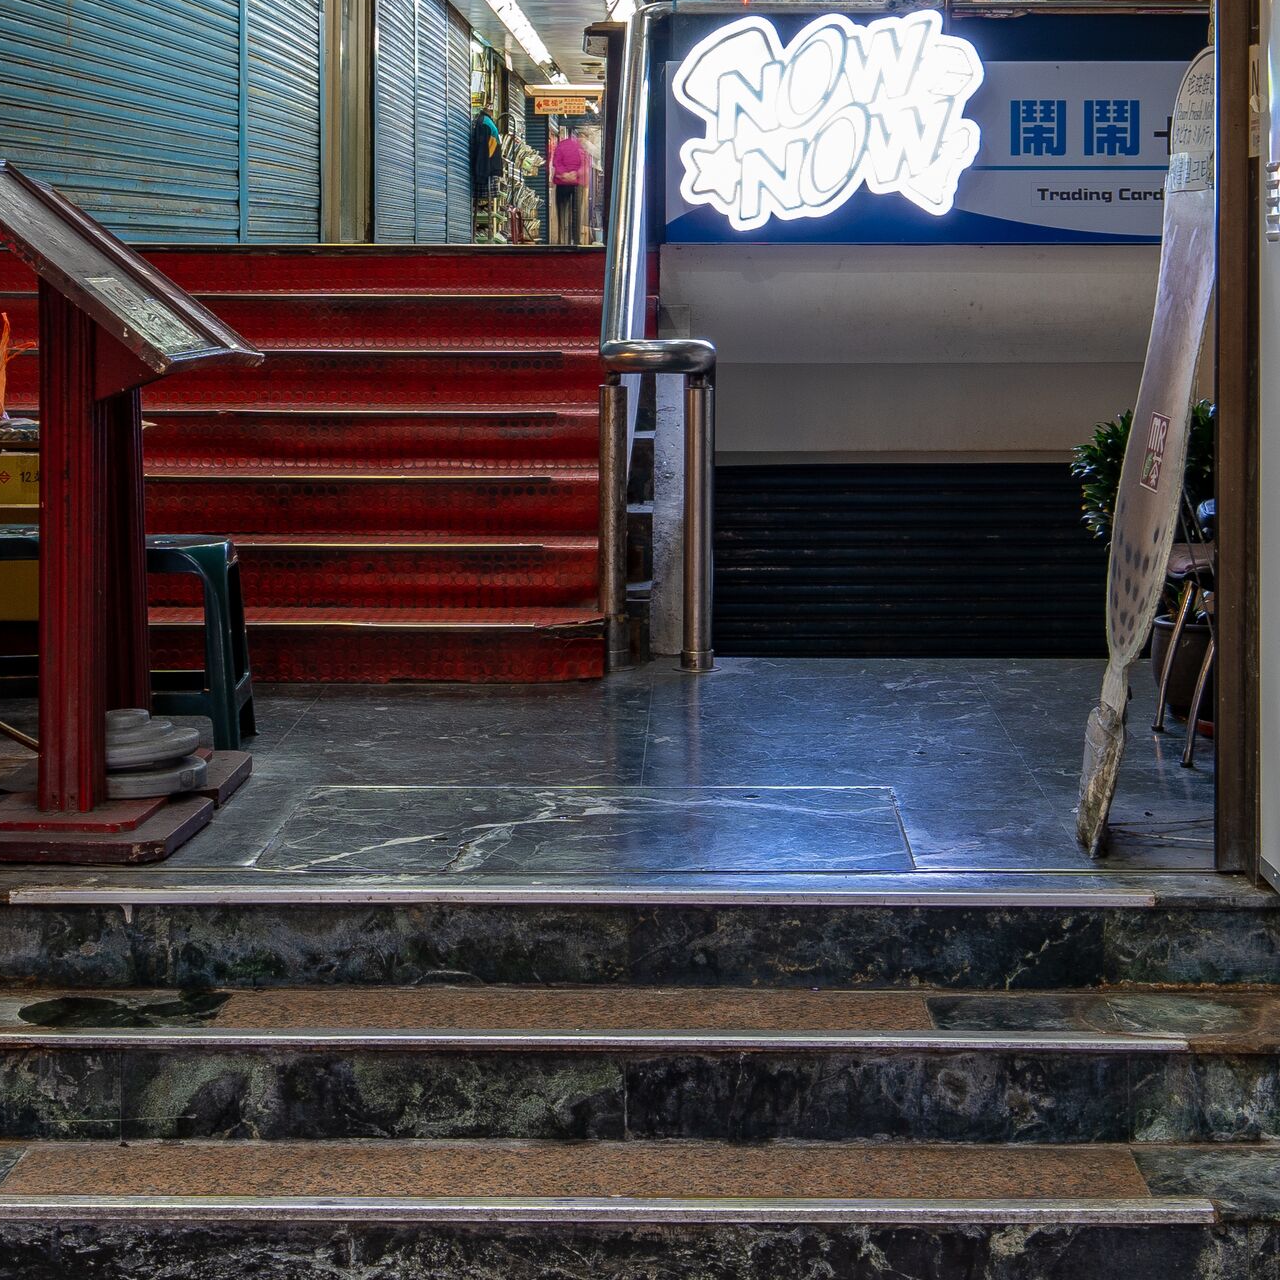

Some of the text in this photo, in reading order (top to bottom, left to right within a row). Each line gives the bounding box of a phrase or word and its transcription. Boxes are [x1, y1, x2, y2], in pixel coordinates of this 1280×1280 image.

[717, 19, 933, 143] NOW
[738, 94, 956, 221] NOW
[1010, 99, 1140, 156] 鬧鬧
[1036, 187, 1113, 203] Trading
